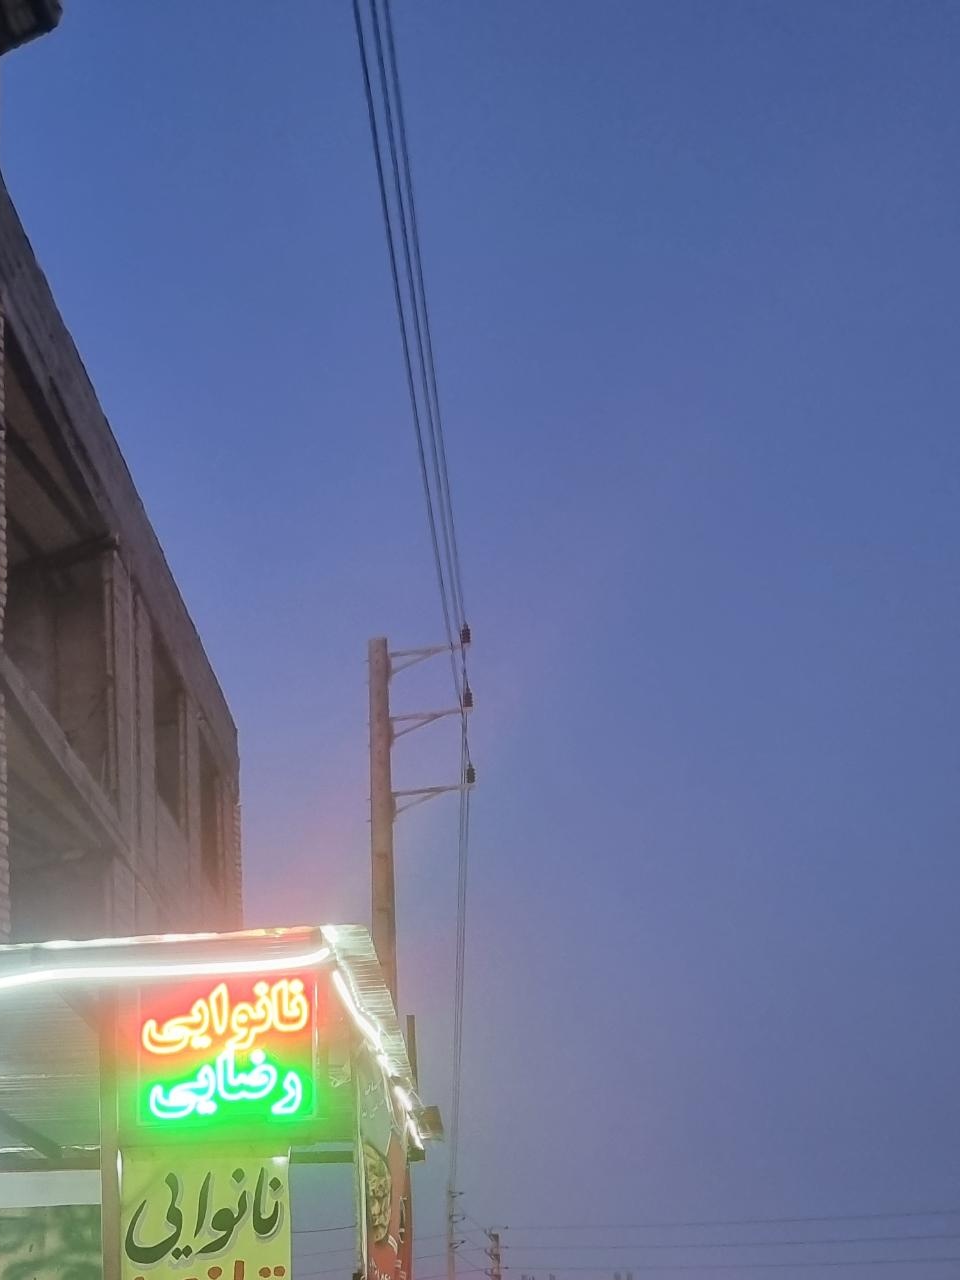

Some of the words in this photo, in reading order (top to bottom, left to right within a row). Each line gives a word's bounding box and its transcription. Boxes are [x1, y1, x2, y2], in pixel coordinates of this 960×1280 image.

[142, 978, 309, 1055] نانوایی
[149, 1045, 303, 1119] رضایی
[124, 1167, 282, 1265] نانوایی
